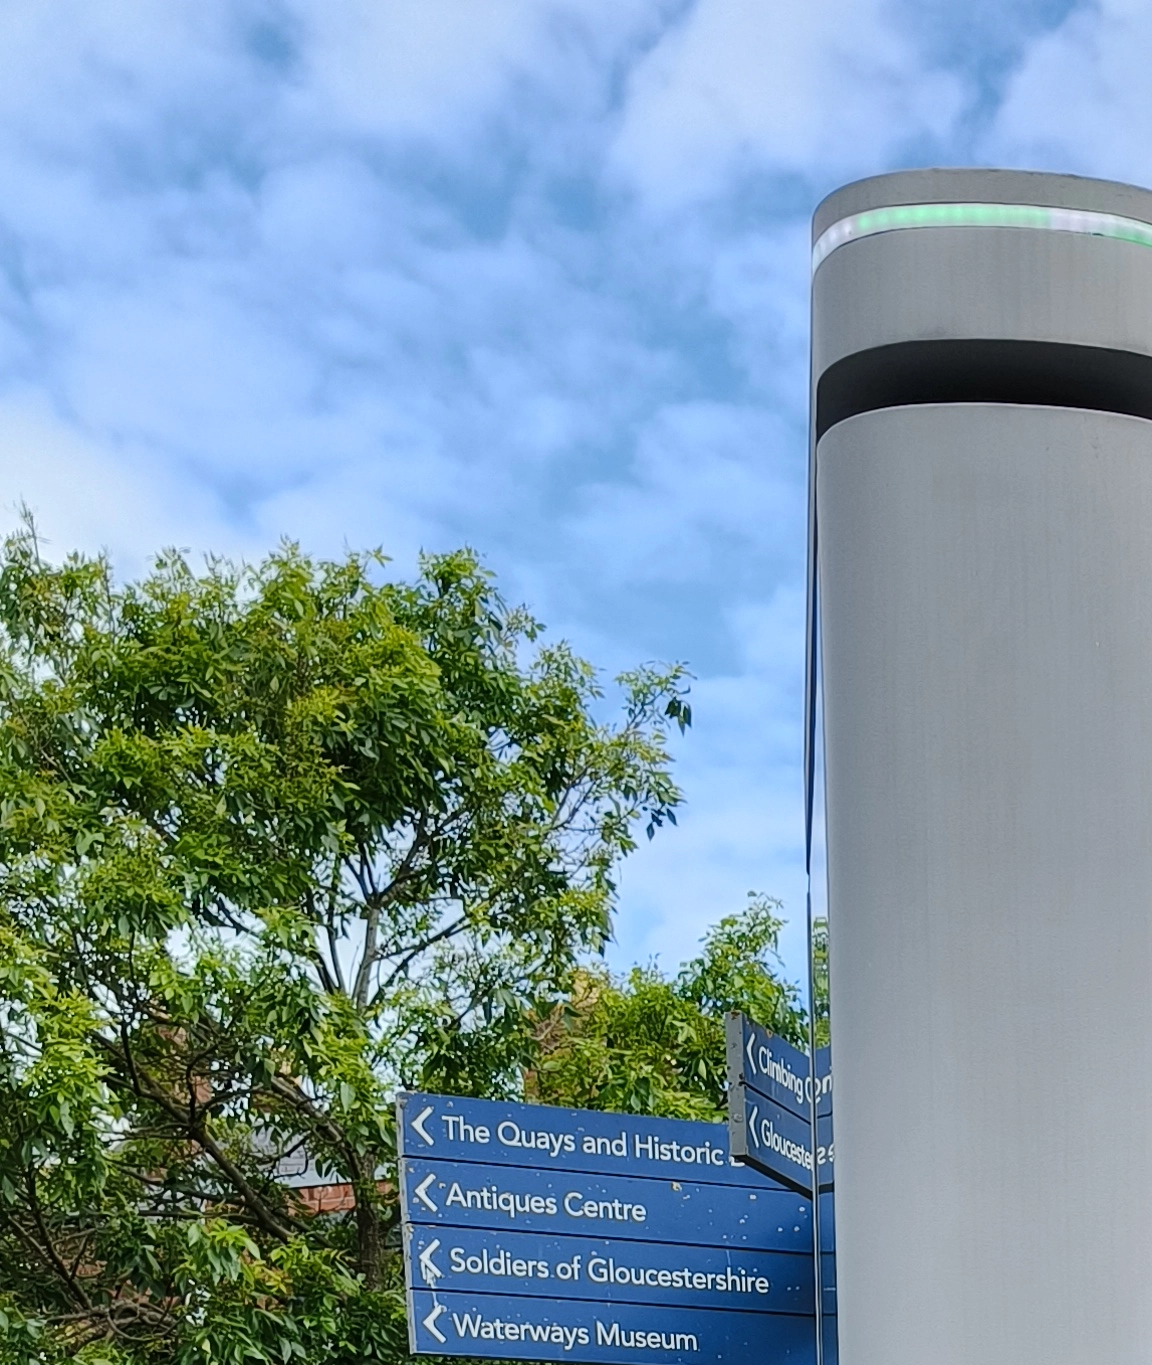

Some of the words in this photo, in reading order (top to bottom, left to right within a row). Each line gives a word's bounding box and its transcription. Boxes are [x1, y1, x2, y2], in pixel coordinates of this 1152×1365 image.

[758, 1045, 804, 1105] Climbing
[442, 1115, 490, 1144] The
[497, 1120, 575, 1157] Quays
[583, 1131, 627, 1157] and
[635, 1135, 724, 1166] Historic
[445, 1182, 557, 1218] Antiques
[564, 1191, 647, 1221] Centre
[450, 1247, 549, 1278] Soldiers
[556, 1254, 581, 1281] of
[587, 1258, 769, 1293] Gloucestershire
[452, 1312, 589, 1350] Waterways
[597, 1322, 697, 1351] Museum
